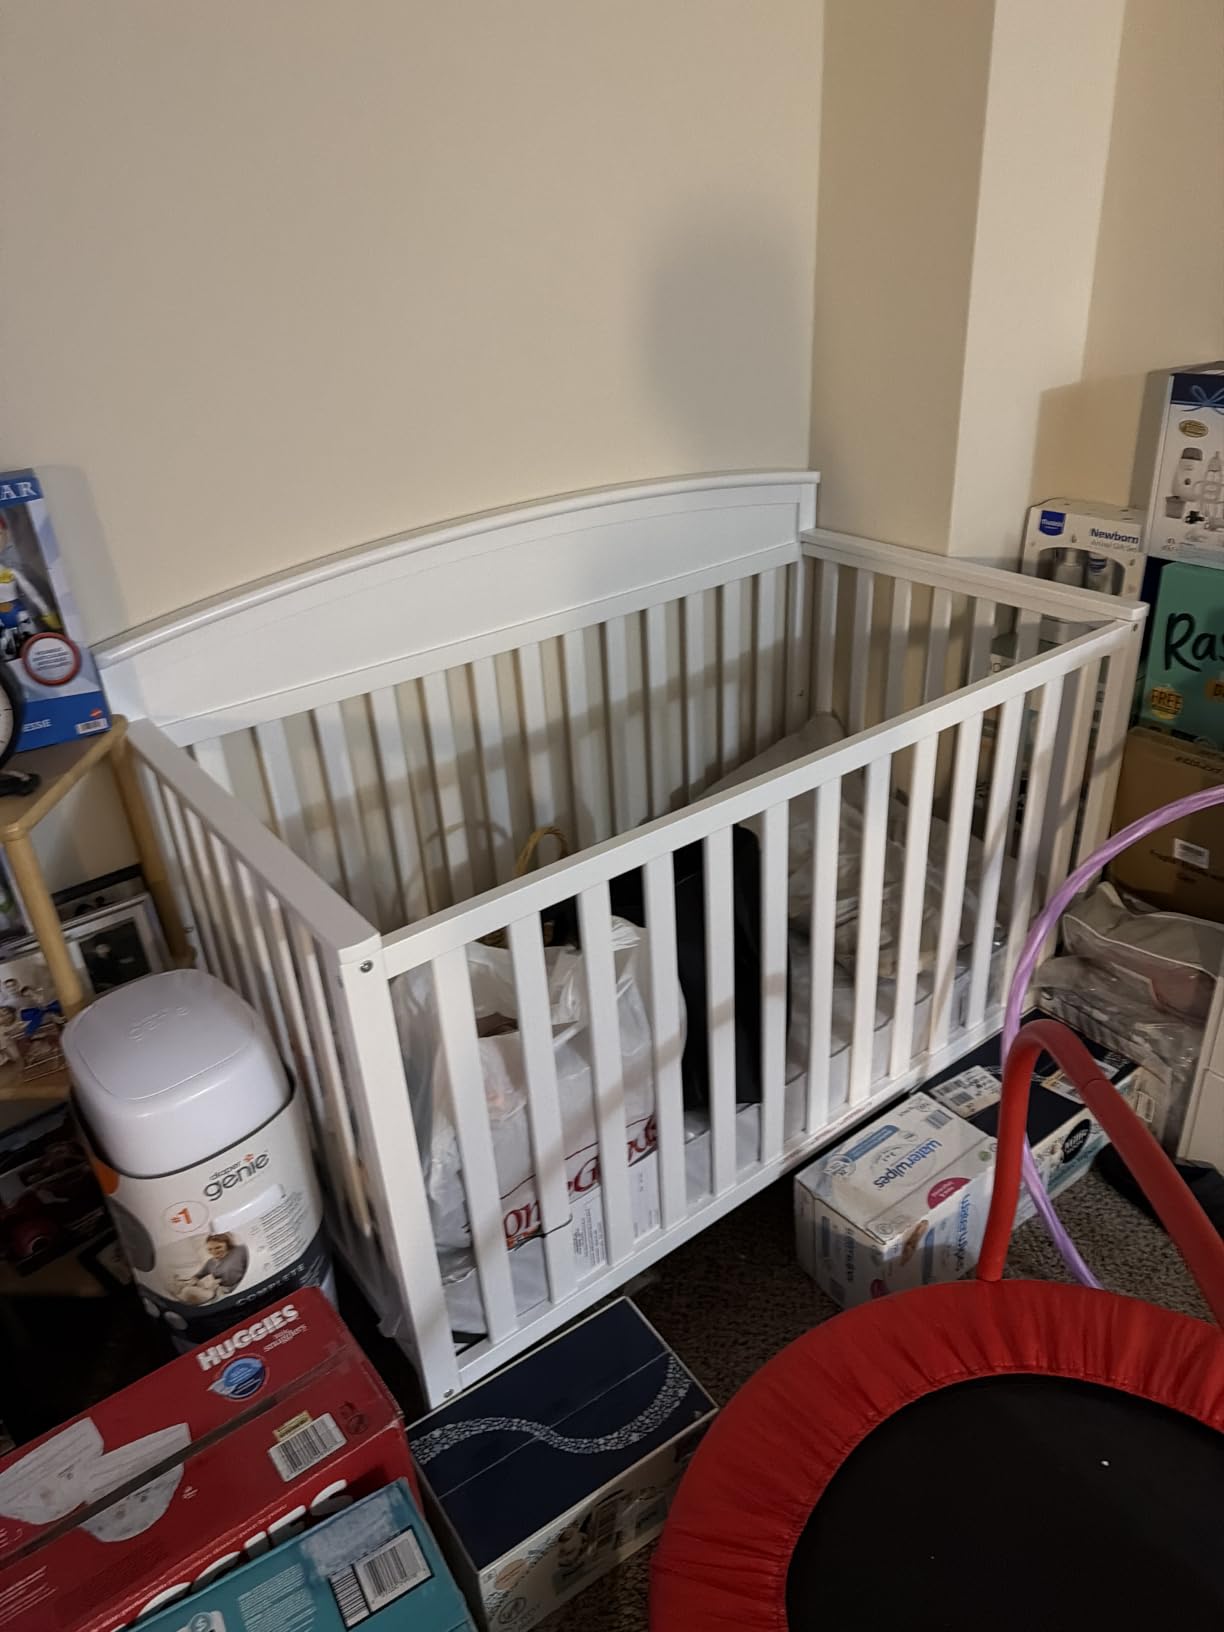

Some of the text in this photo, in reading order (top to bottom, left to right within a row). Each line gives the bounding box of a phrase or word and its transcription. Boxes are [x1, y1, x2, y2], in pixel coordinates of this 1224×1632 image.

[1090, 528, 1139, 544] Newborn
[1151, 689, 1183, 709] FREE
[22, 718, 51, 732] ESSIE
[203, 1151, 270, 1201] genie
[238, 1263, 306, 1306] COMPLETE
[196, 1304, 300, 1371] HUGGIES
